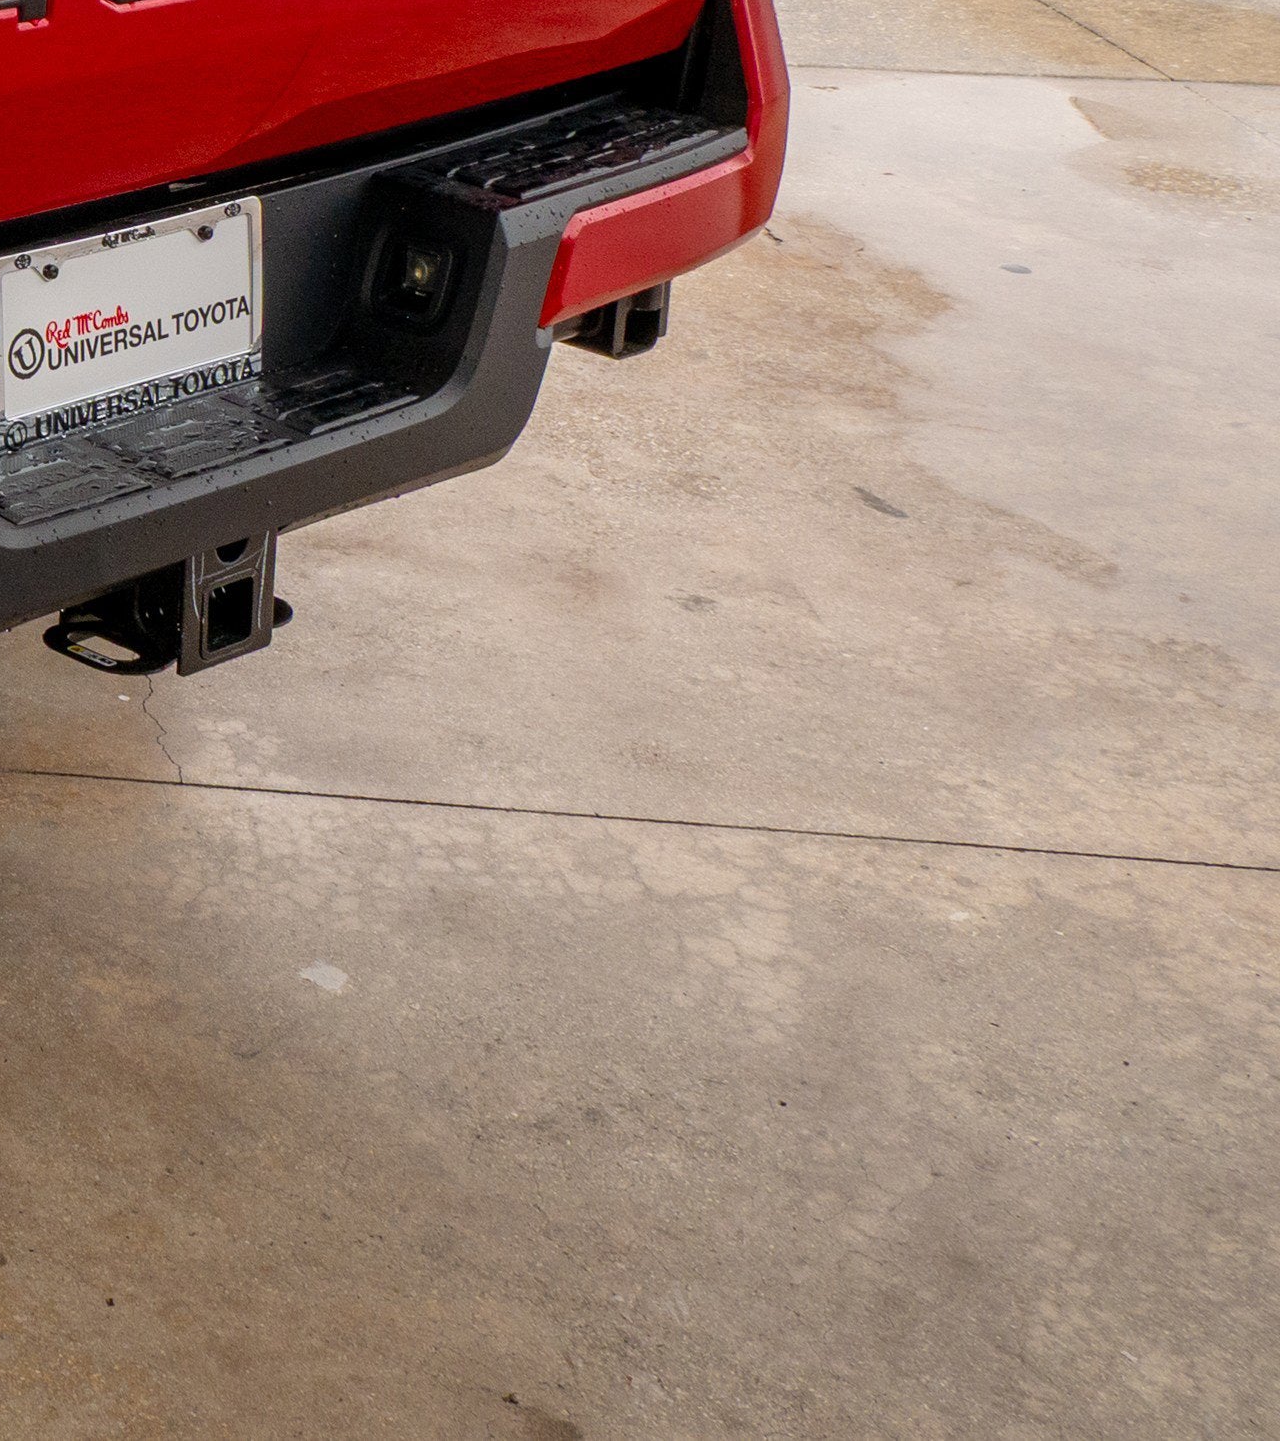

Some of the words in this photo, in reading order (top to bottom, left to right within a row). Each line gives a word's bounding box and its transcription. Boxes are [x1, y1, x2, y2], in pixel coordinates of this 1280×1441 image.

[46, 319, 71, 349] Red
[73, 305, 129, 337] McCombs
[47, 317, 169, 370] UNIVERSAL
[171, 295, 250, 335] TOYOTA
[35, 384, 171, 439] UNIVERSAL
[171, 357, 255, 401] TOYOTA
